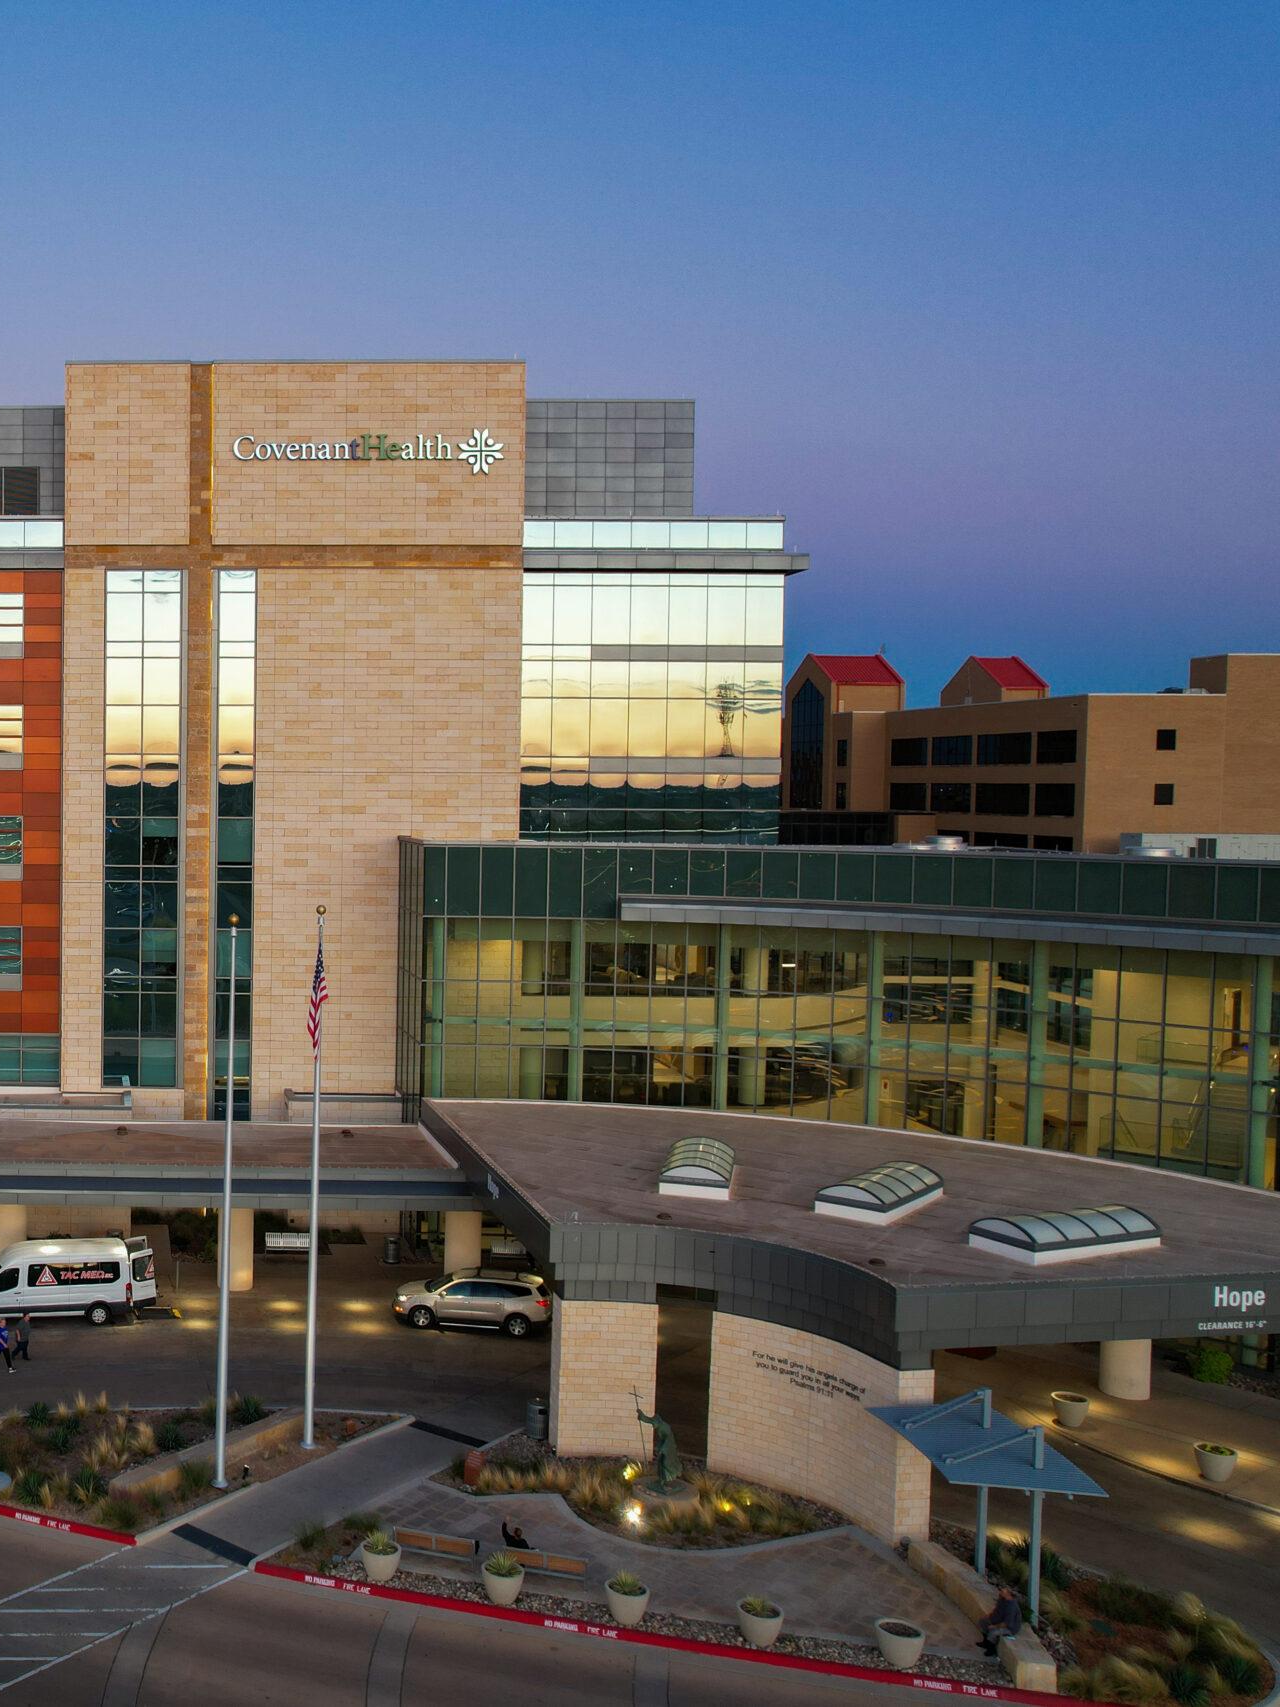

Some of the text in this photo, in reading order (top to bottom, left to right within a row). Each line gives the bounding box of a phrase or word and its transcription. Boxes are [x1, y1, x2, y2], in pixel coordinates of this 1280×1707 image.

[60, 1270, 80, 1280] TAC
[1214, 1286, 1266, 1312] Hope
[1198, 1321, 1244, 1331] CLEARANCE
[752, 1350, 764, 1359] For
[789, 1361, 804, 1370] give
[806, 1364, 816, 1373] his
[816, 1369, 838, 1382] angels
[839, 1378, 859, 1392] charge
[756, 1361, 770, 1369] you
[771, 1363, 778, 1371] to
[779, 1367, 800, 1377] guard
[800, 1373, 814, 1382] you
[815, 1376, 821, 1384] in
[831, 1384, 844, 1394] your
[15, 1512, 22, 1520] NO
[22, 1513, 41, 1524] PARKING
[313, 1576, 336, 1587] PARKING
[343, 1582, 355, 1592] FIRE
[356, 1585, 371, 1595] LANE
[544, 1619, 618, 1639] NO PARKING FIRE LANE
[913, 1679, 999, 1698] NO PARKING FIRE LANE
